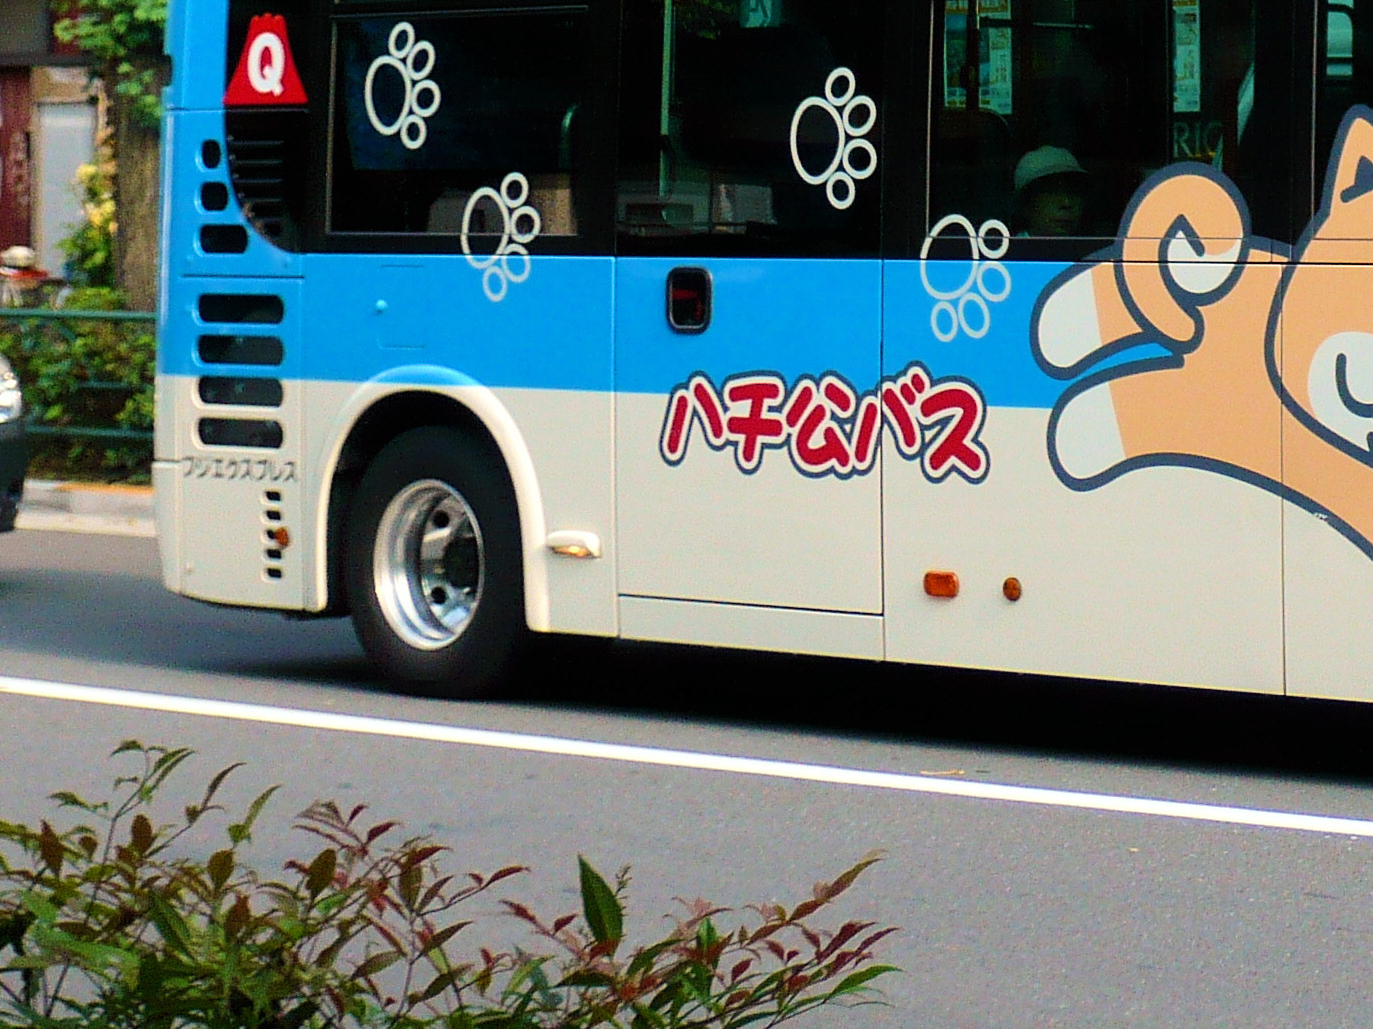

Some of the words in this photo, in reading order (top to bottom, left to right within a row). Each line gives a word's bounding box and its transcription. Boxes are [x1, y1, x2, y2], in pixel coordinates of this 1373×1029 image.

[247, 32, 285, 97] Q
[662, 363, 988, 482] ハチ公バス
